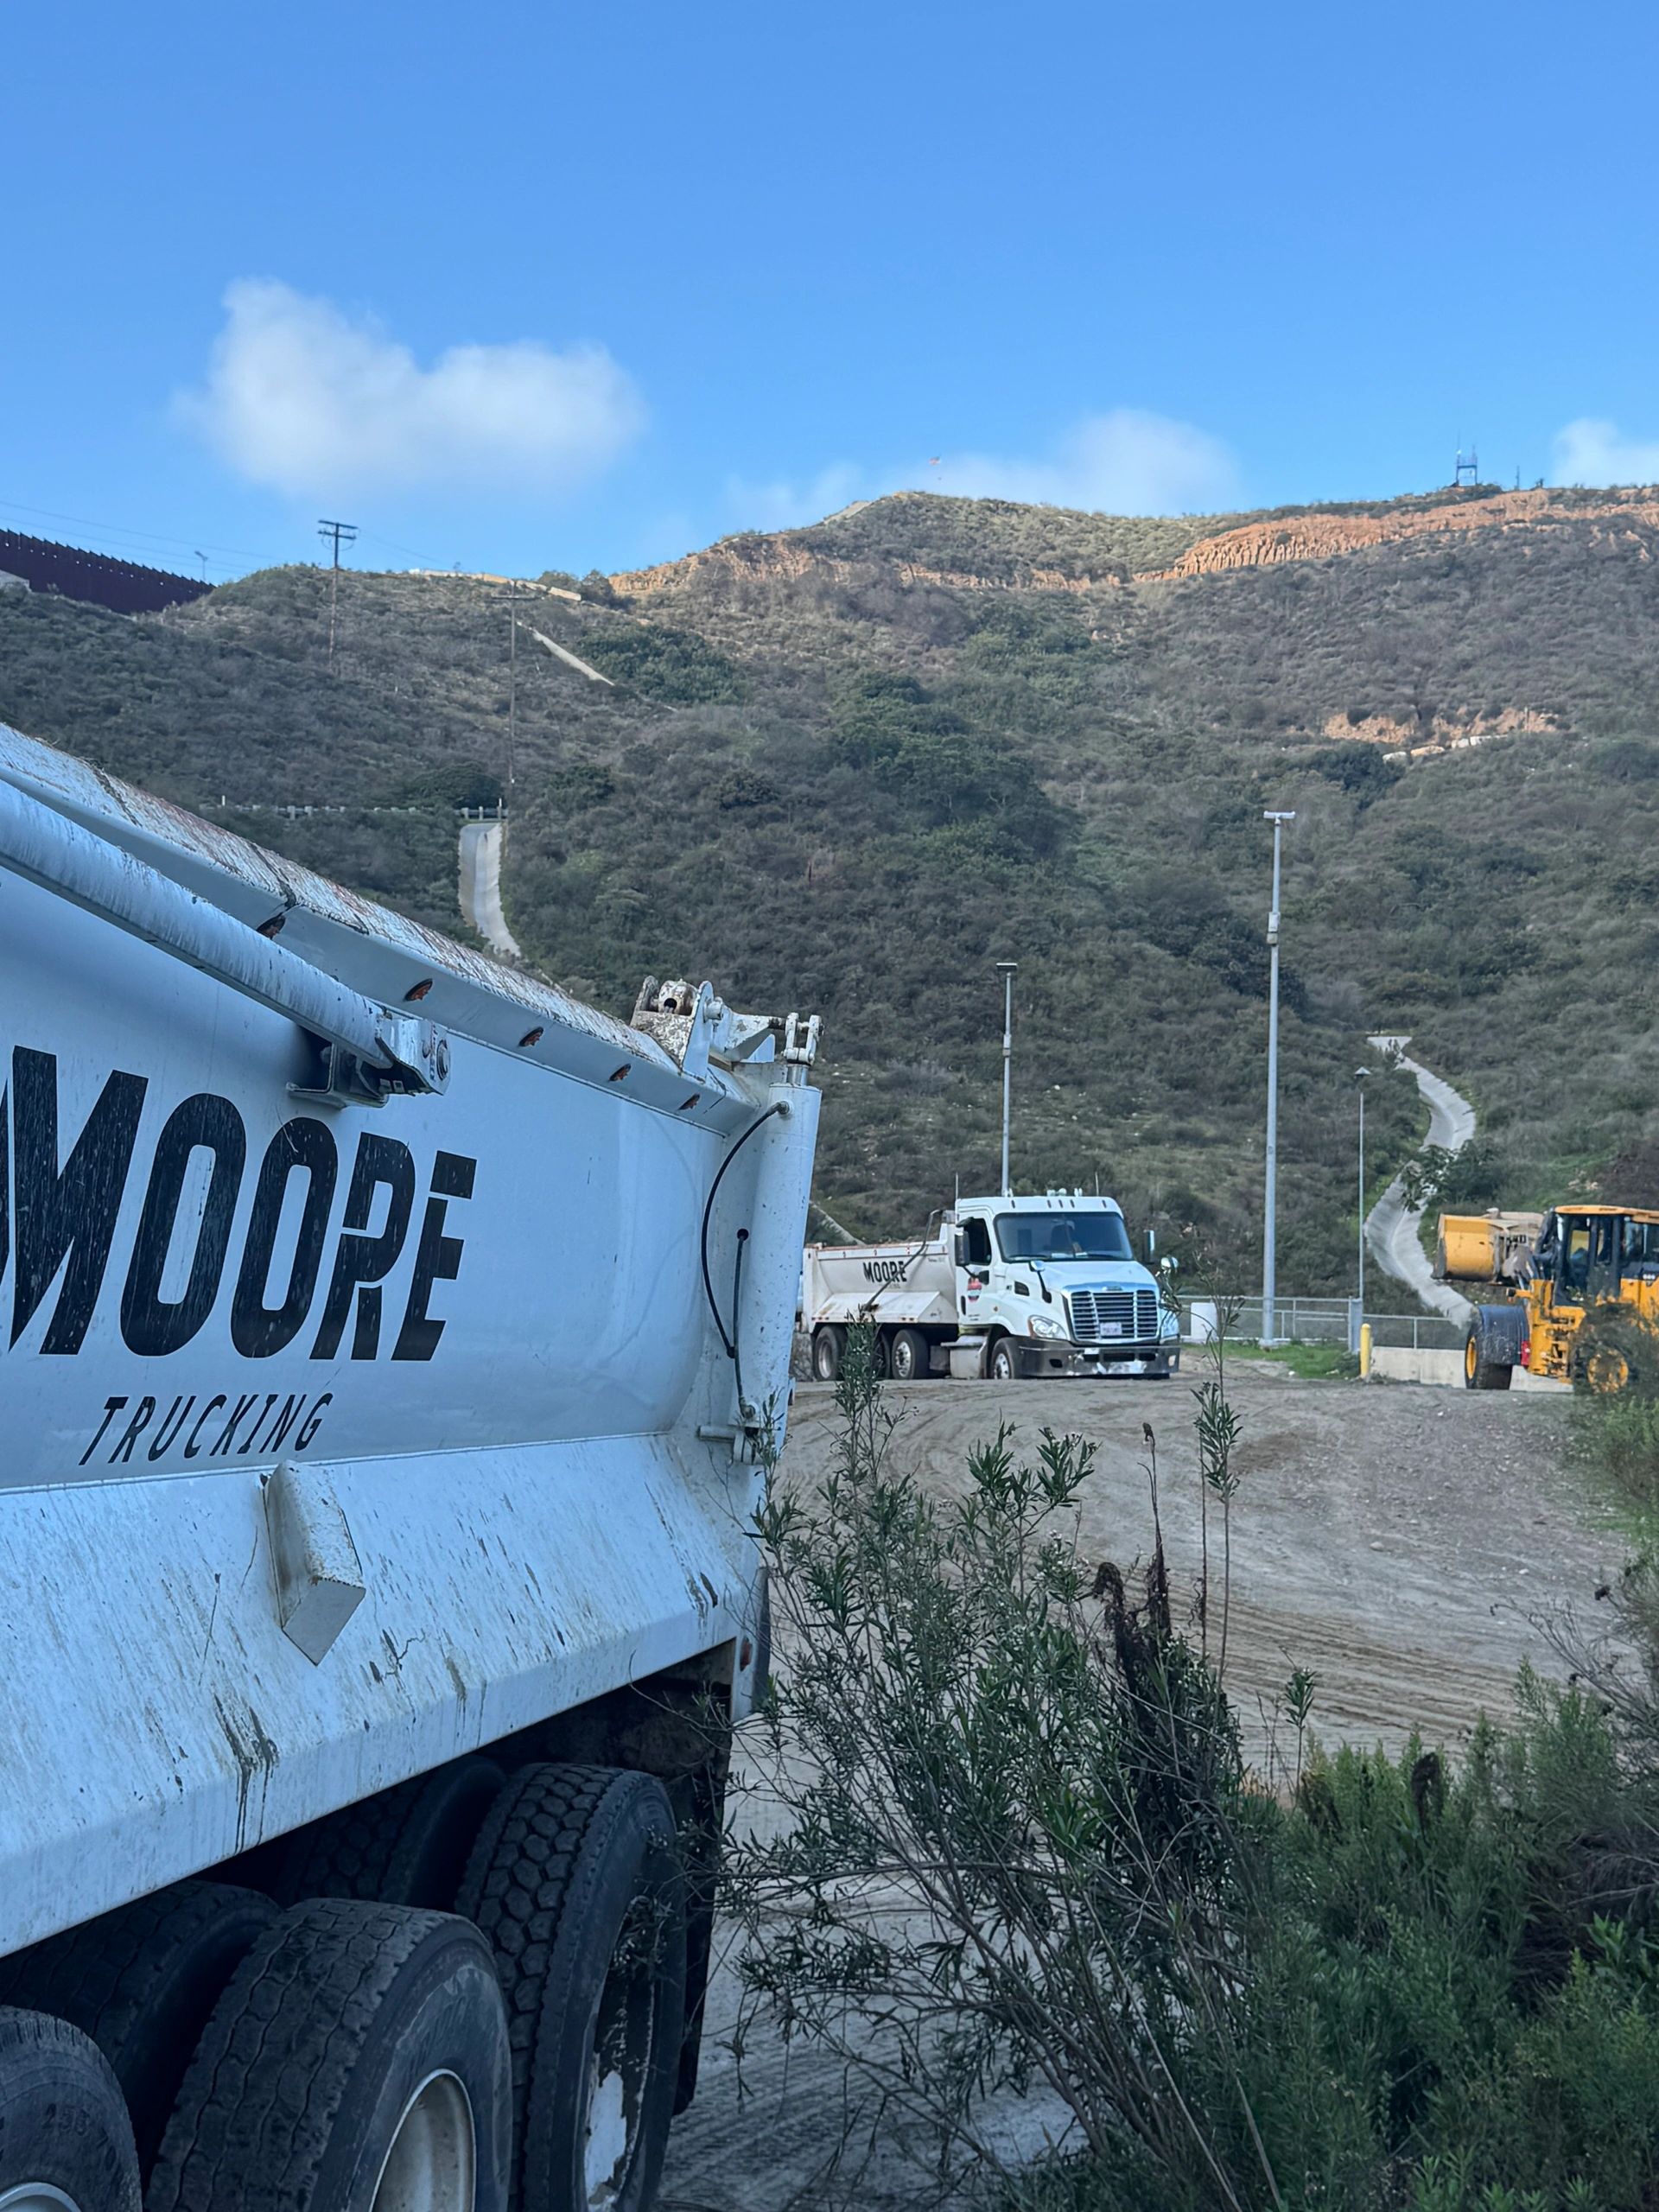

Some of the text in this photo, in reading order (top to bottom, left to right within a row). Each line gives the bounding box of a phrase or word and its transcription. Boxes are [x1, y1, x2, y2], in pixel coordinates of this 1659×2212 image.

[0, 1046, 477, 1362] MOORE
[863, 1261, 907, 1283] MOORE
[79, 1393, 334, 1465] TRUCKING
